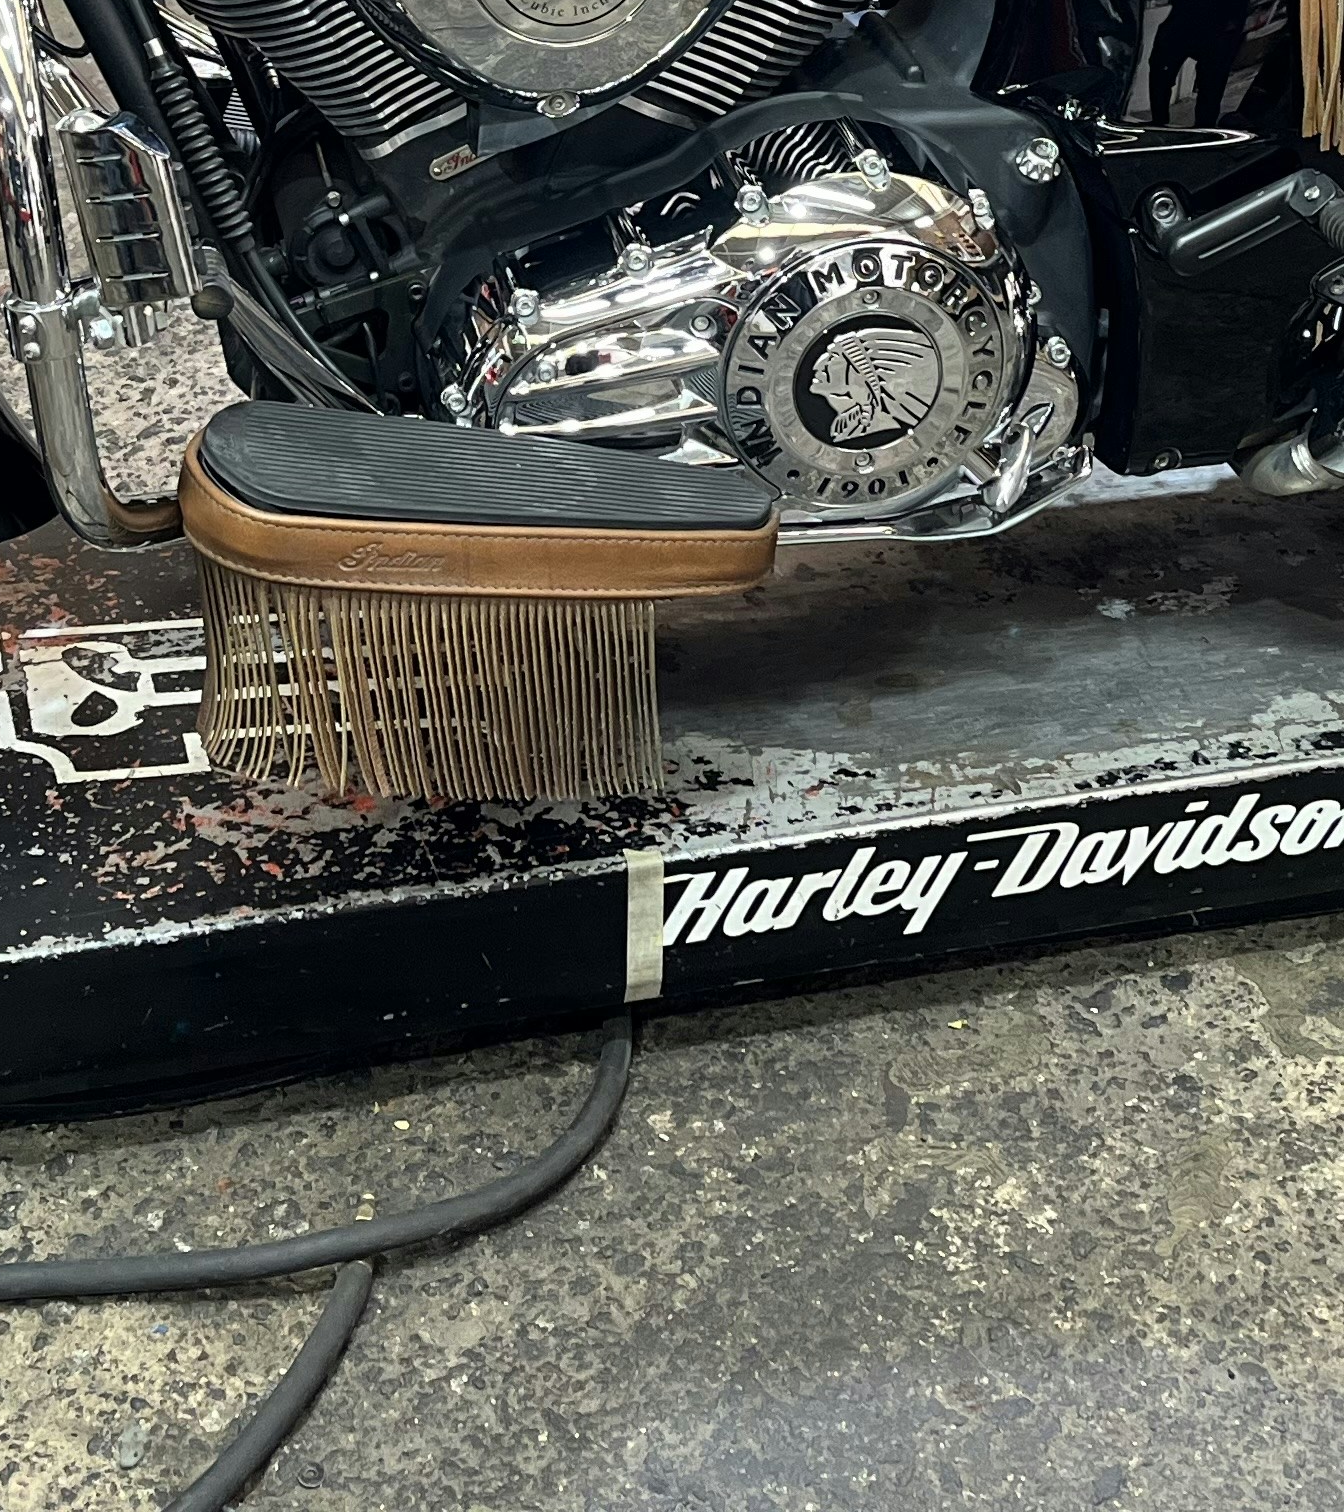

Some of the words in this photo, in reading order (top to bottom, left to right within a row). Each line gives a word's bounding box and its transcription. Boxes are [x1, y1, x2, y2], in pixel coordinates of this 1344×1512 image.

[736, 292, 803, 469] INDIAN
[810, 247, 998, 446] MOTORCYCLE
[816, 469, 910, 498] 1901
